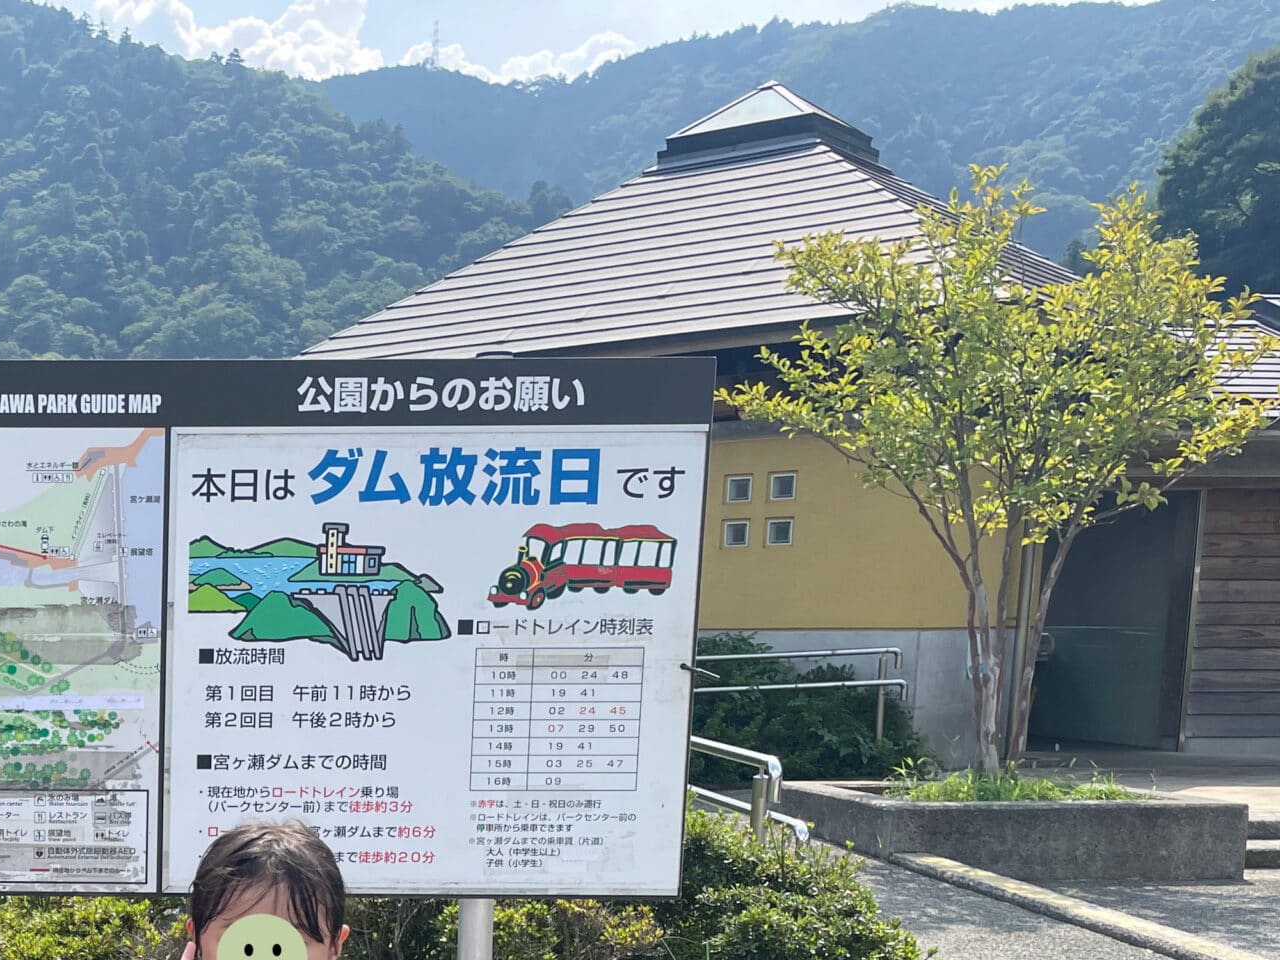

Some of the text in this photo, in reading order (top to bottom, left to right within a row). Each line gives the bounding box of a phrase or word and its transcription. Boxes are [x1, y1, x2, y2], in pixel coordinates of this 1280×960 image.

[296, 376, 586, 413] 公園からのお願い
[37, 393, 78, 414] PARK
[80, 393, 125, 414] GUIDE
[127, 393, 162, 415] MAP
[191, 447, 686, 507] 本日は ダム放流日 です
[476, 618, 654, 637] ロードトレイン時刻表
[214, 648, 285, 665] 放流時間
[499, 653, 594, 663] 時 分
[491, 671, 628, 681] 10時 00 24 48
[205, 684, 412, 702] 第1回目 午前11時から
[490, 688, 596, 698] 11時 19 41
[489, 706, 626, 716] 12時 02 24 45
[204, 712, 396, 729] 第2回目 午後2時から
[488, 724, 626, 734] 13時 07 29 50
[487, 741, 593, 751] 14時 19 41
[487, 759, 623, 769] 15時 03 25 47
[486, 776, 562, 786] 16時 09
